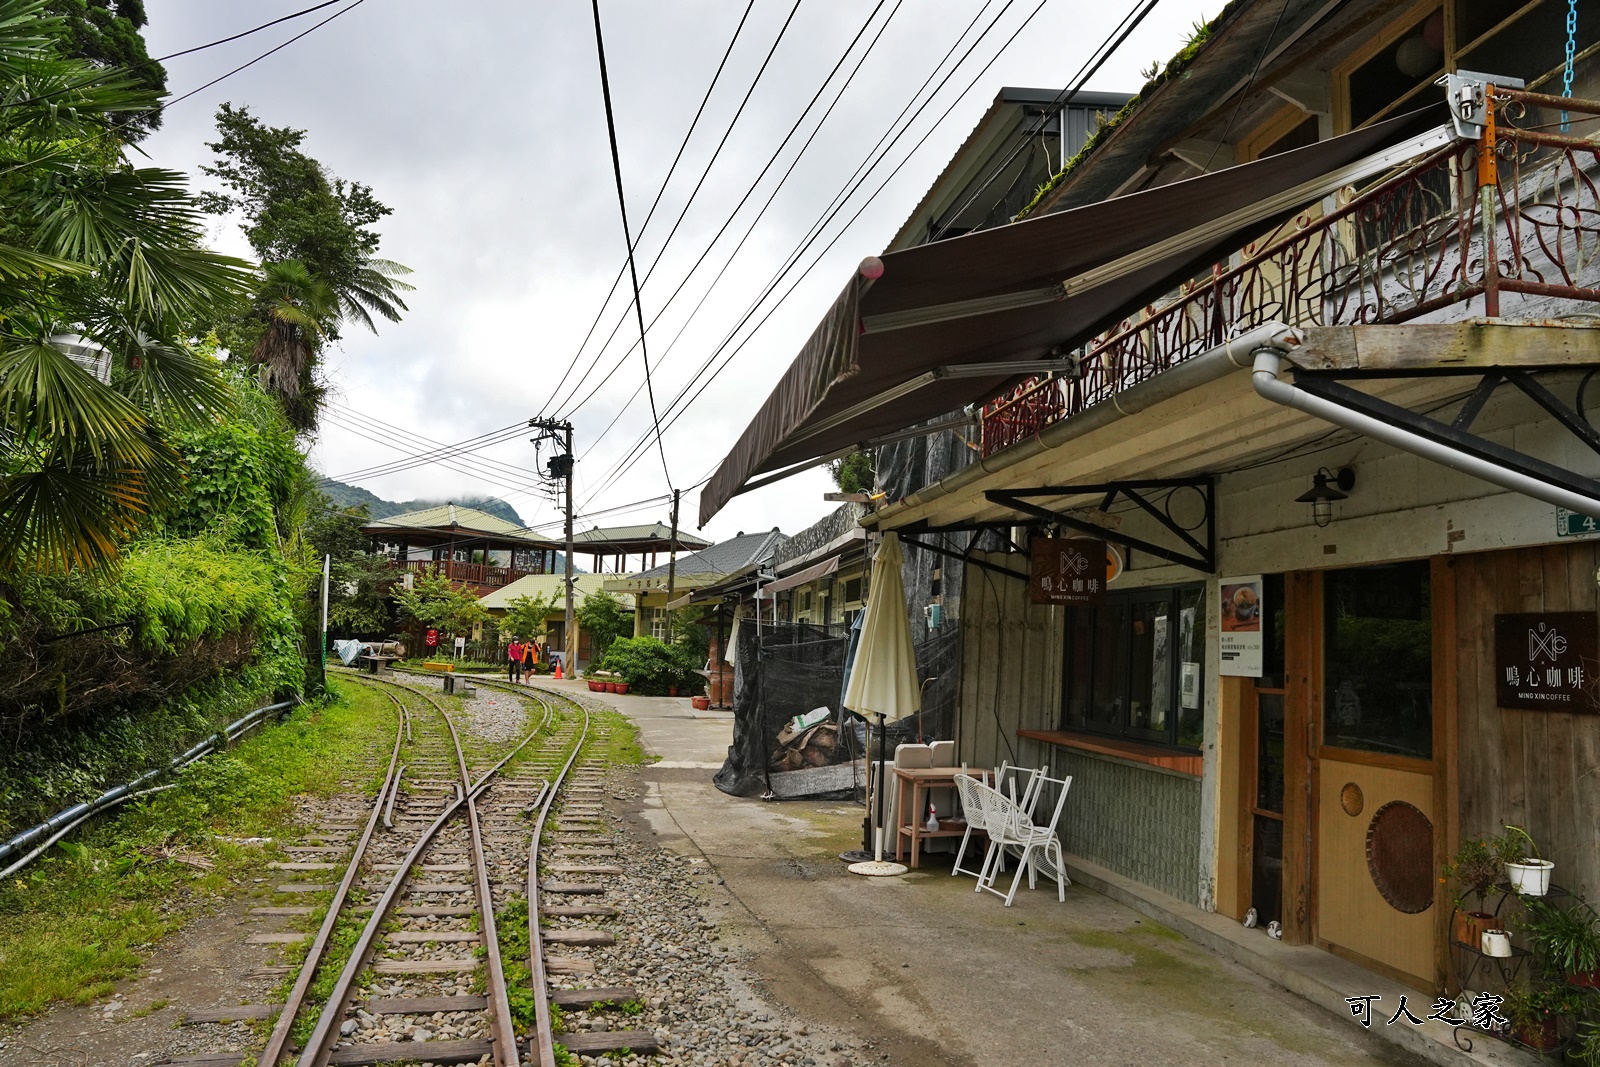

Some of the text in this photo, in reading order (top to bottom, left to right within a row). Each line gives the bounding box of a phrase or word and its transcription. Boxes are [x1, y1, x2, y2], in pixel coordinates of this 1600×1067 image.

[1582, 516, 1596, 531] 4
[1041, 576, 1098, 593] 鳴心咖啡
[1506, 665, 1584, 689] 鳴心咖啡
